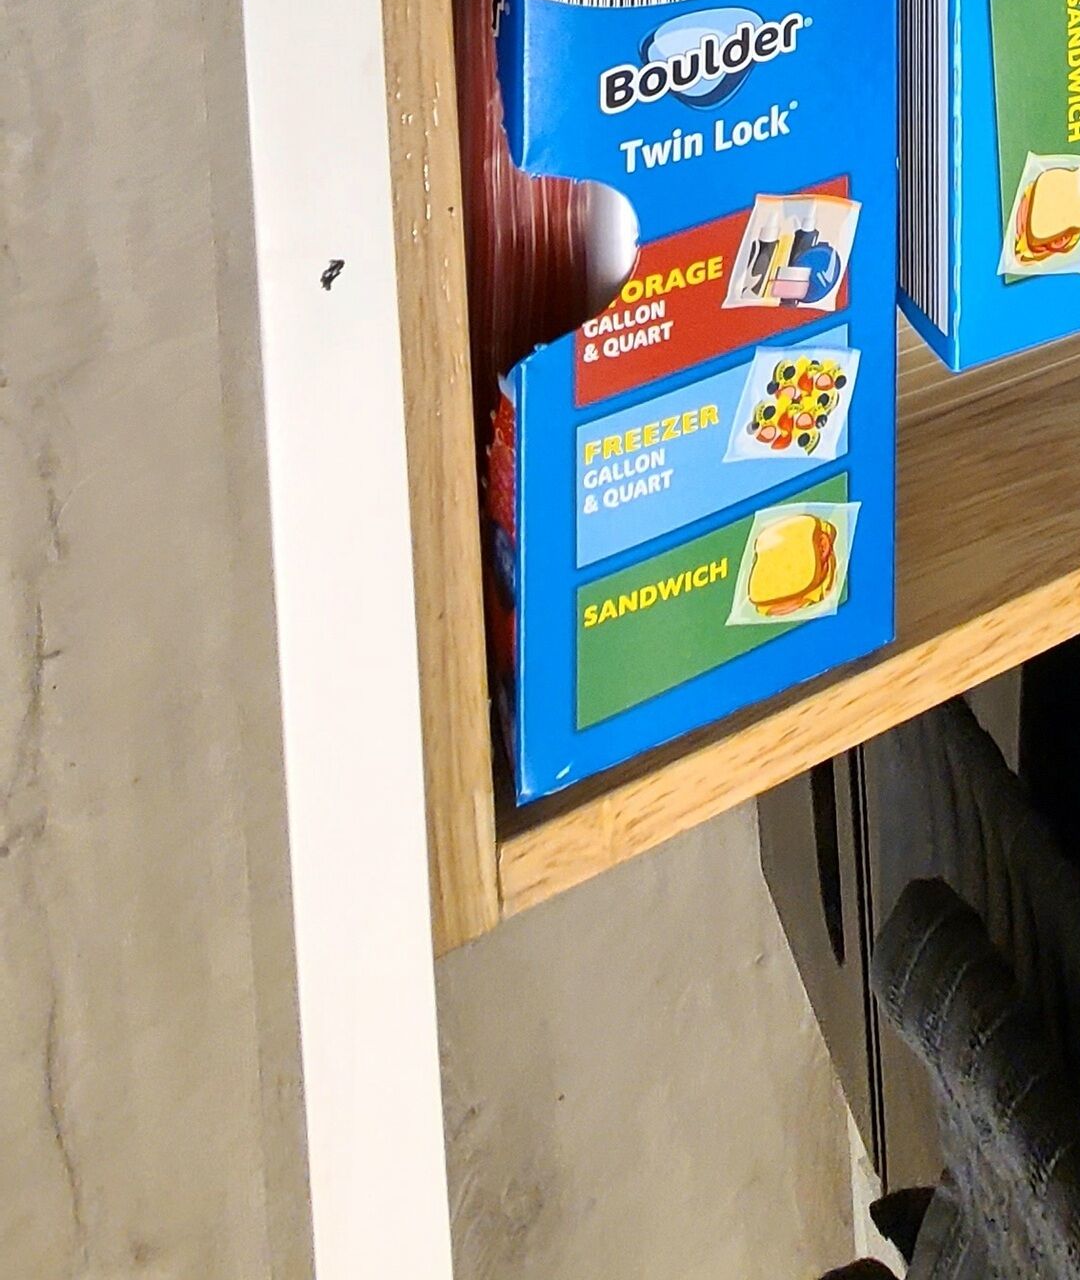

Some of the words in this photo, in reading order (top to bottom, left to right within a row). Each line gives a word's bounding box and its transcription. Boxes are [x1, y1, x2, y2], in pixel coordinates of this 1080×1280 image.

[598, 11, 804, 116] Boulder
[618, 126, 704, 176] Twin
[713, 103, 792, 153] Lock
[607, 255, 724, 310] ORAGE
[581, 299, 667, 339] GALLON
[582, 342, 600, 364] &
[602, 320, 675, 358] QUART
[583, 403, 720, 466] FREEZER
[582, 447, 666, 490] GALLON
[582, 493, 599, 516] &
[602, 468, 675, 509] QUART
[583, 557, 729, 629] SANDWICH
